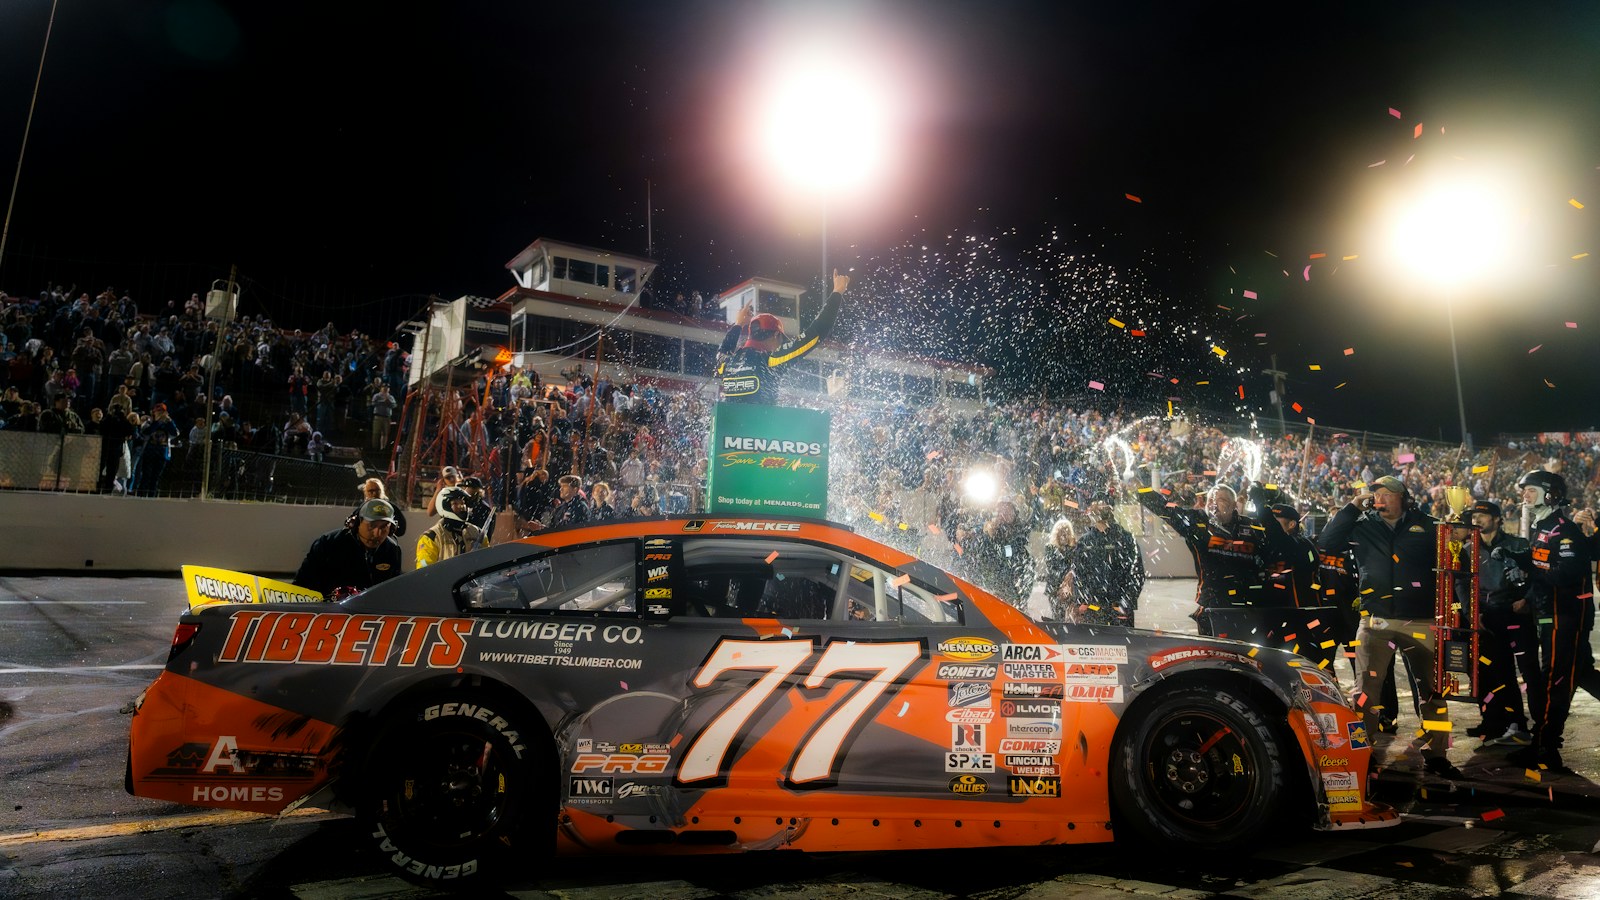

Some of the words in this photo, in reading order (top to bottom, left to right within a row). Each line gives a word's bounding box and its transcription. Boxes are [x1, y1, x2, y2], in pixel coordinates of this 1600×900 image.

[724, 436, 821, 455] MENARDS
[722, 454, 756, 467] Save
[717, 496, 734, 504] Shop
[735, 497, 753, 506] today
[735, 522, 801, 532] MCKEE
[647, 565, 669, 578] WIX
[195, 574, 253, 603] MENARDS
[217, 610, 477, 669] TIBBETTS
[478, 619, 597, 642] LUMBER
[602, 625, 644, 645] CO.
[553, 640, 574, 648] Since
[554, 647, 572, 655] 1949
[937, 642, 999, 653] MENARDS
[1003, 645, 1042, 660] ARCA
[479, 651, 643, 670] WWW.TIBBETTSLUMBER.COM
[1151, 649, 1208, 669] GENERAL
[938, 665, 997, 678] COMETIC
[1004, 663, 1053, 675] QUARTER
[1013, 671, 1056, 679] MASTER
[1003, 682, 1043, 698] Holley
[675, 636, 924, 787] 77
[945, 709, 995, 723] Eibach
[1016, 705, 1061, 714] ILMOR
[424, 702, 528, 760] GENERAL
[1009, 724, 1054, 735] Intercomp
[1002, 740, 1047, 751] COMP
[570, 753, 672, 774] PRG
[1007, 756, 1052, 766] LINCOLN
[1320, 754, 1349, 767] Reese's
[572, 779, 610, 795] TWG
[952, 783, 986, 793] CALLIES
[1011, 779, 1057, 794] UNOH
[192, 786, 284, 802] HOMES
[372, 822, 478, 880] GENERAL
